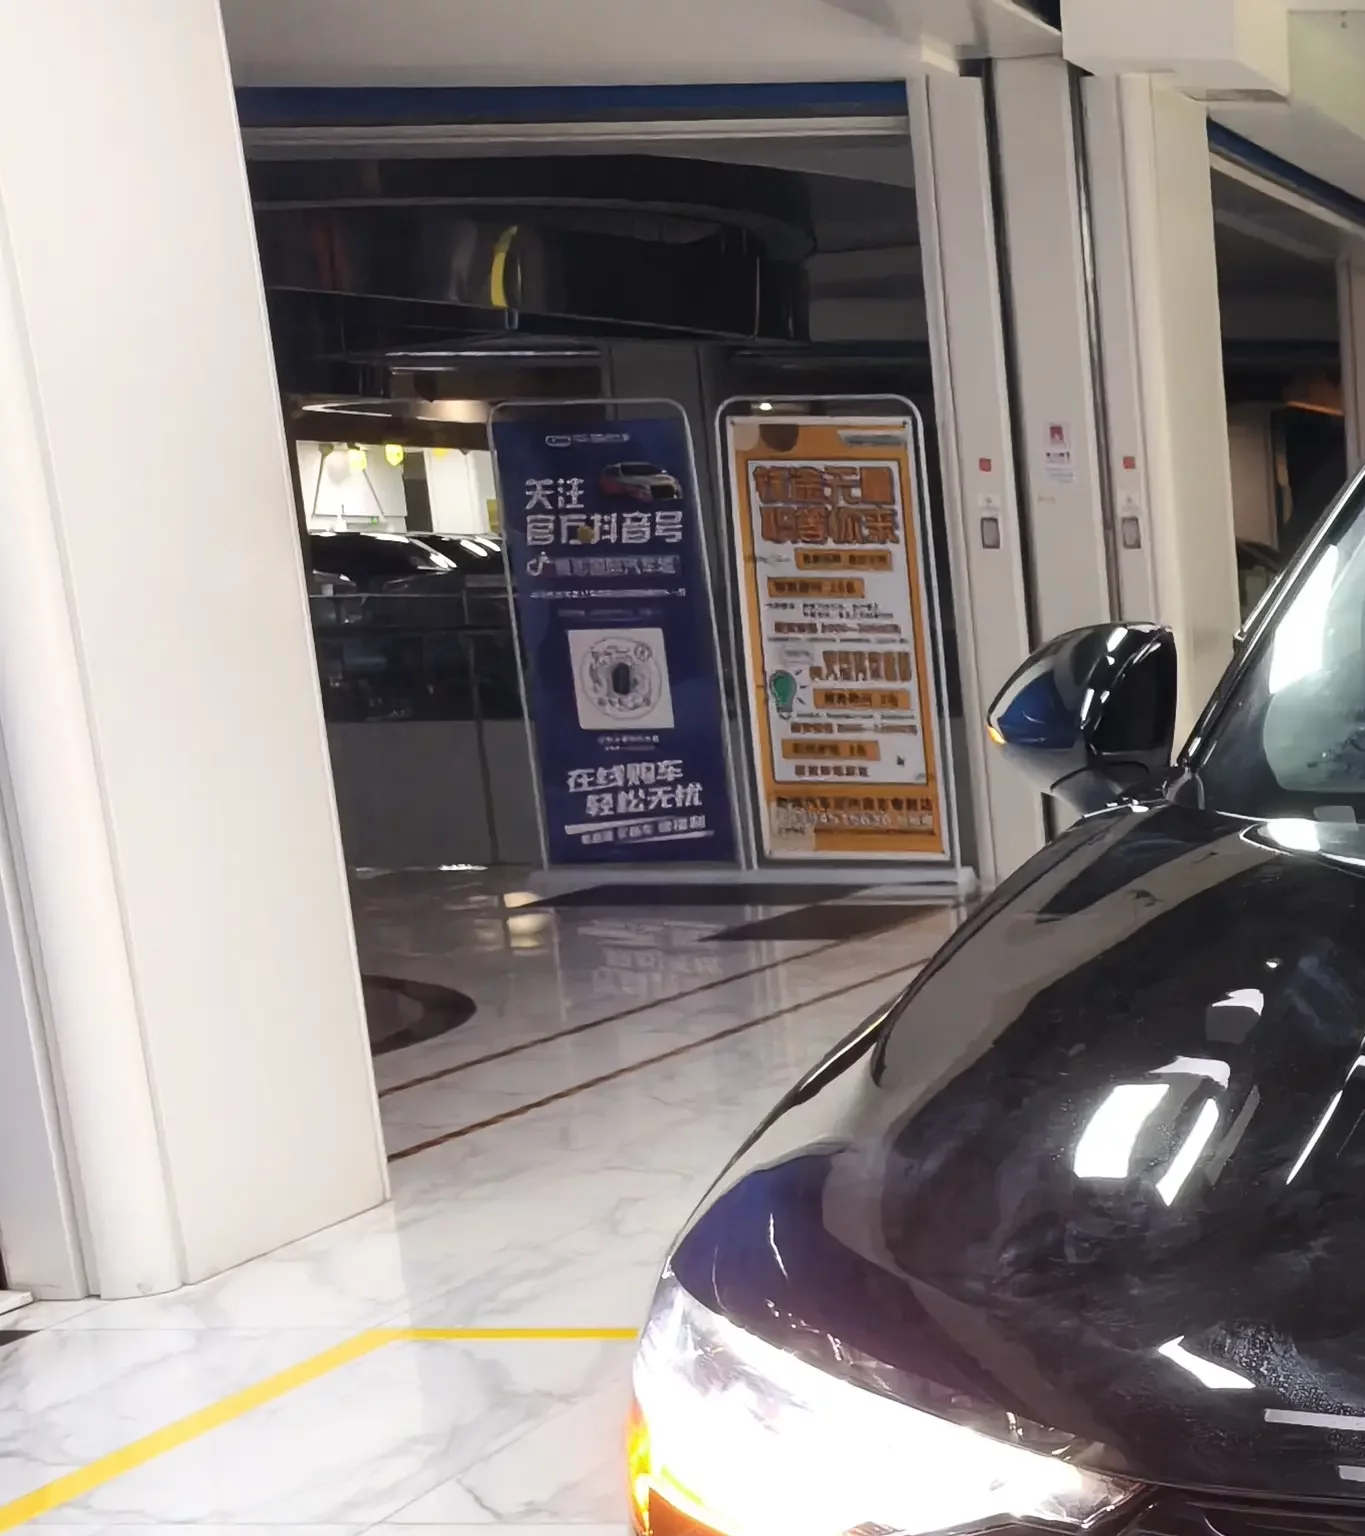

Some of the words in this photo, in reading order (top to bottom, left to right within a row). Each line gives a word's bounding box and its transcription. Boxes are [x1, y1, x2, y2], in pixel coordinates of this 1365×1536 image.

[525, 477, 585, 510] 关注
[526, 511, 683, 546] 官方抖音号
[566, 760, 683, 793] 在线购车
[585, 782, 703, 817] 轻松无忧
